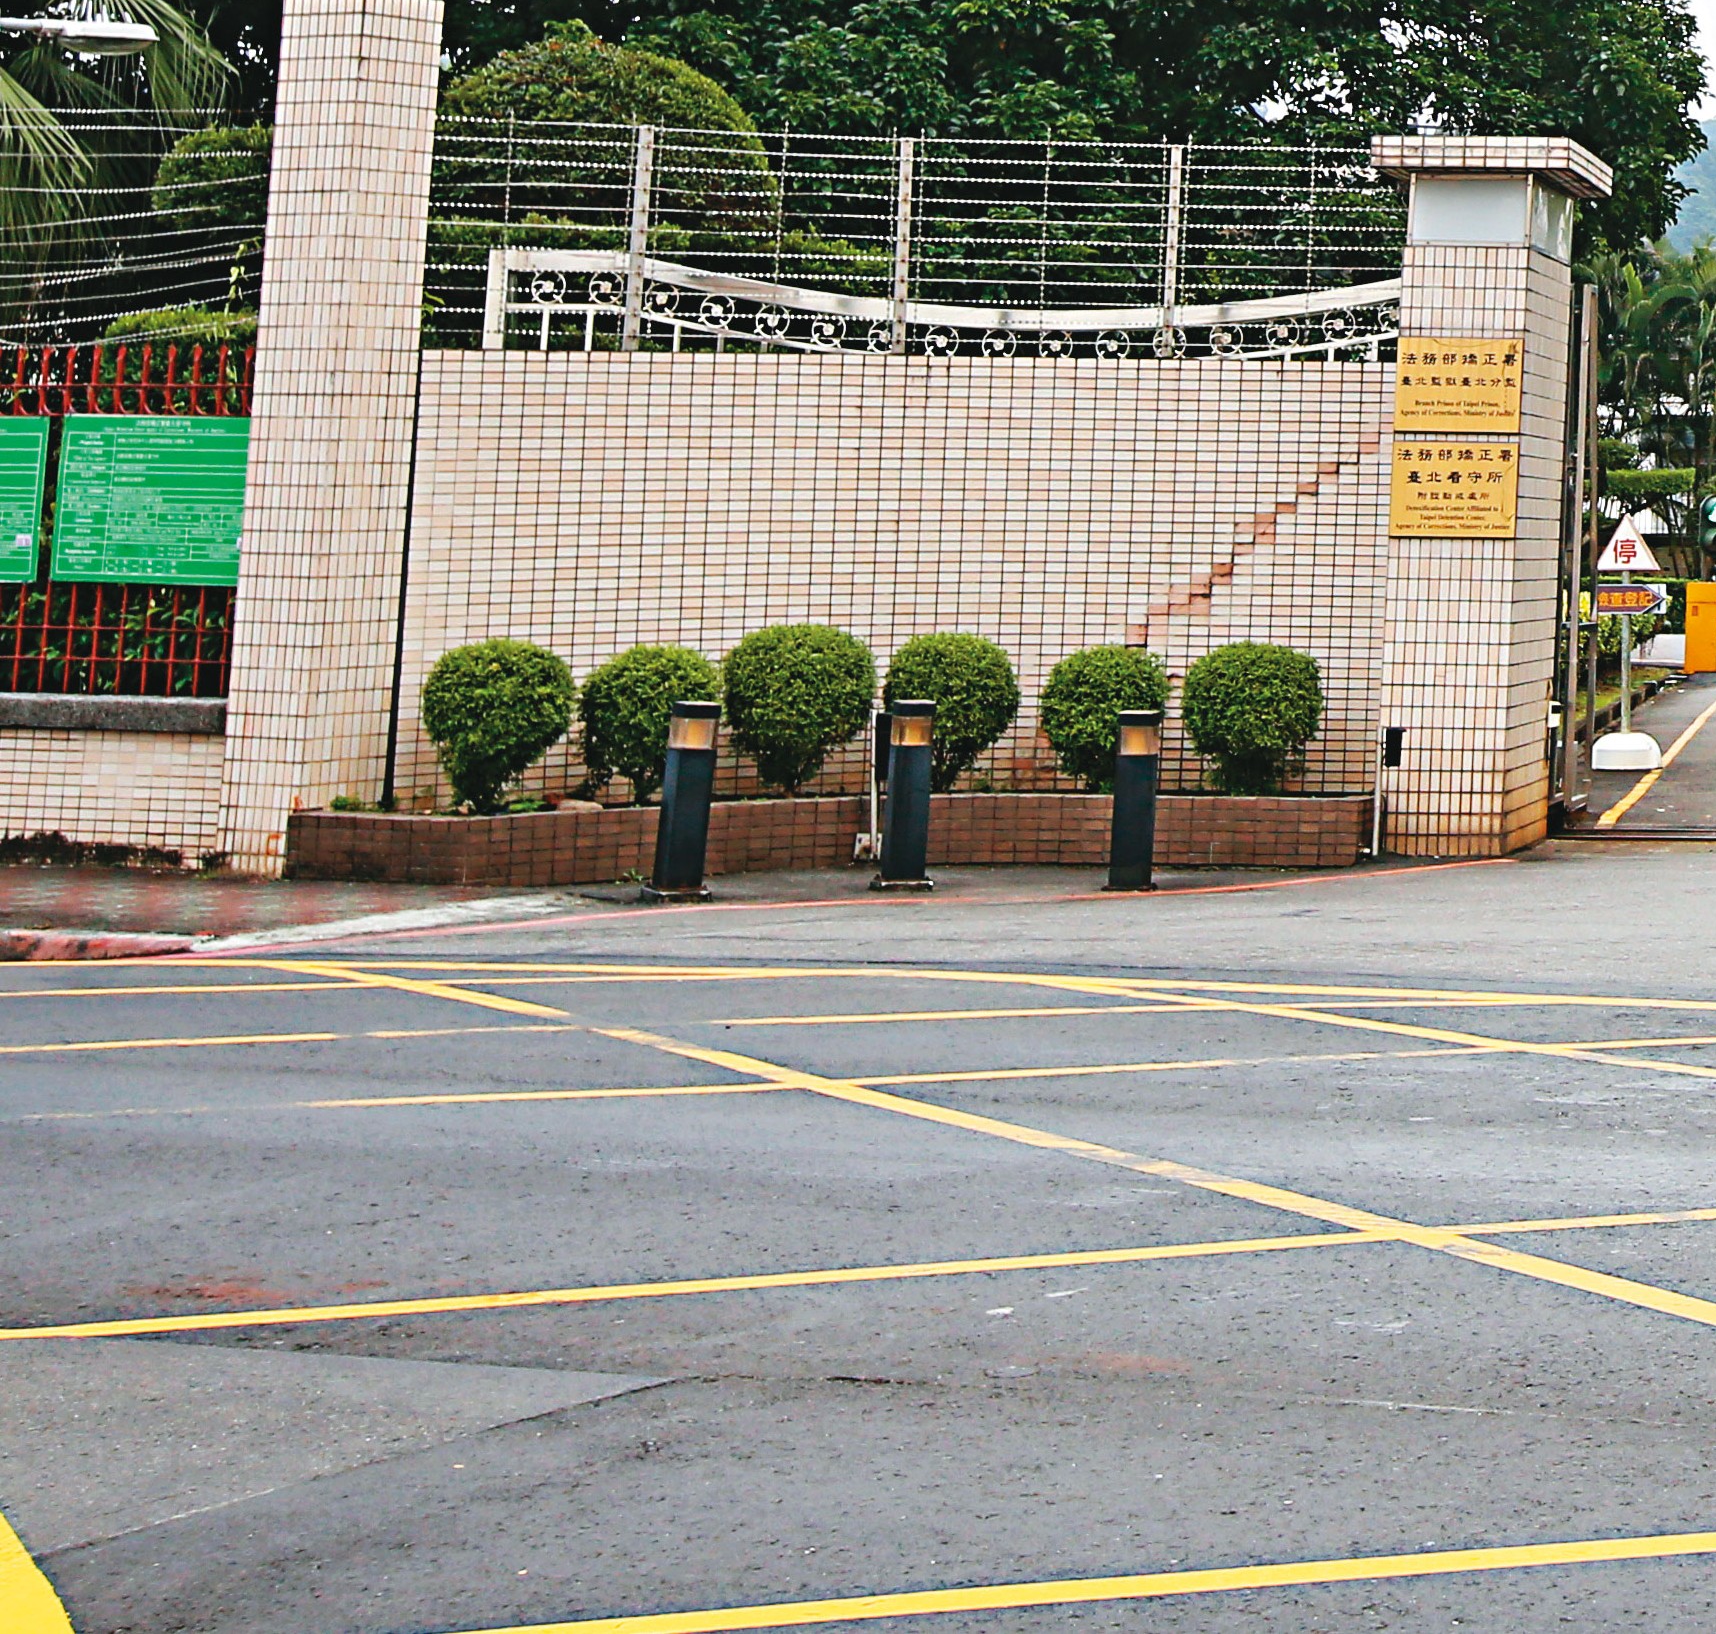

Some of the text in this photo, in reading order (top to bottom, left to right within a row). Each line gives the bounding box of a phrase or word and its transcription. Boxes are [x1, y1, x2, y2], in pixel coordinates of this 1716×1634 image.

[1401, 352, 1518, 366] 法務部矯正署
[1401, 376, 1517, 387] 臺北監獄臺北分監
[1397, 449, 1514, 462] 法務部矯正署
[1406, 471, 1503, 484] 臺北看守所
[1613, 539, 1637, 564] 停
